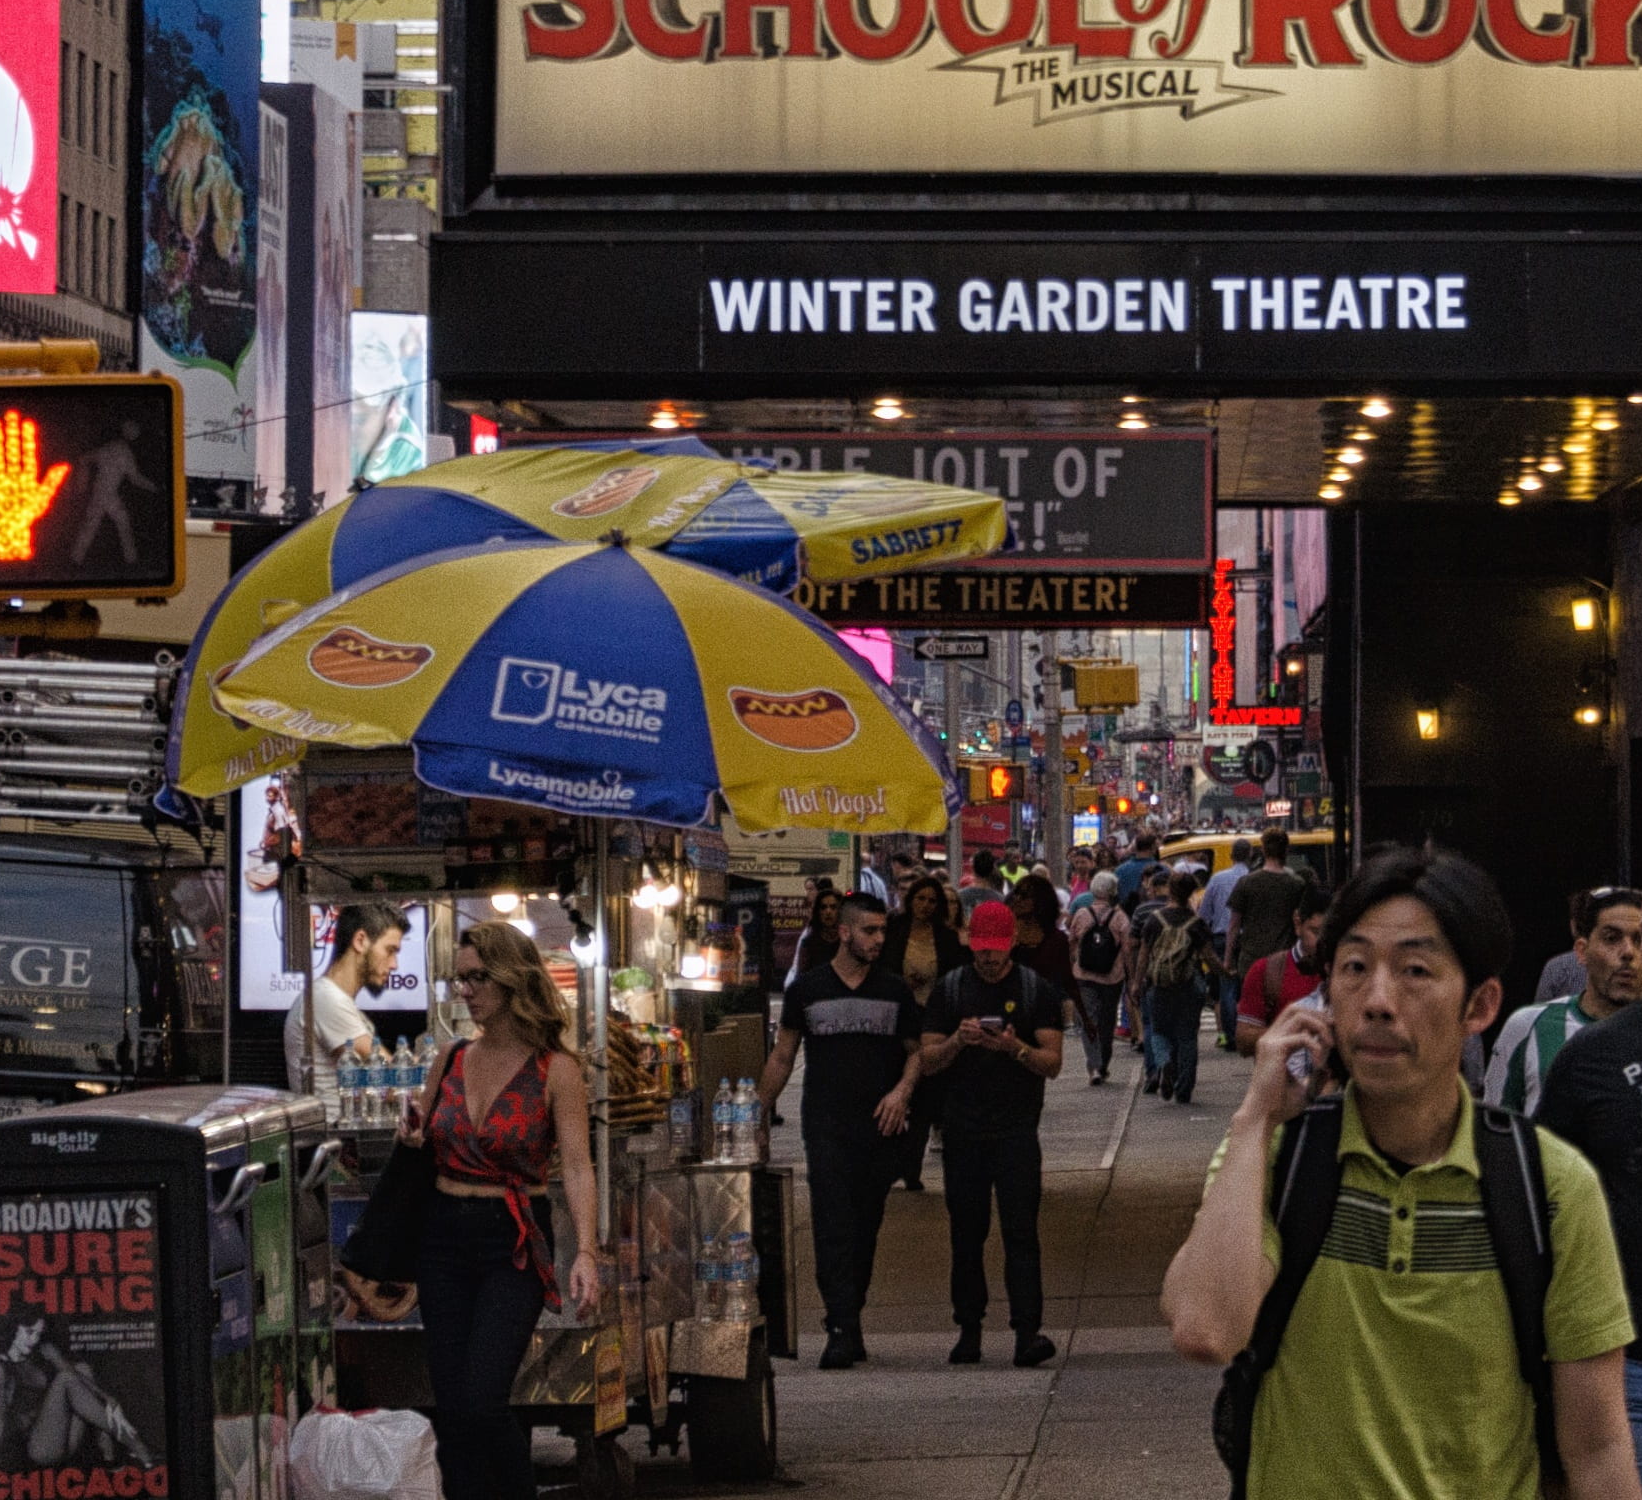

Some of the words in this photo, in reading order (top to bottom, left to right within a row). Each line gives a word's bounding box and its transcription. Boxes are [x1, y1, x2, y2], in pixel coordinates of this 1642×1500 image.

[1012, 56, 1061, 84] THE
[1049, 67, 1200, 111] MUSICAL
[710, 280, 936, 332] WINTER
[957, 280, 1186, 332] GARDEN
[1213, 277, 1467, 330] THEATRE
[1053, 447, 1123, 498] OF
[850, 519, 963, 564] SABRETT
[793, 577, 857, 611] OFF
[873, 577, 941, 611] THE
[926, 643, 949, 654] ONE
[956, 643, 979, 654] WAY
[1209, 559, 1236, 708] PLAYWRIGHT
[562, 671, 667, 711] Lyca
[557, 703, 662, 731] mobile
[1209, 707, 1301, 726] TAVERN
[489, 761, 636, 800] Lycamobile
[780, 787, 818, 815] Hot
[825, 787, 885, 822] Dogs!
[31, 1131, 98, 1148] BigBelly
[57, 1144, 90, 1153] SOLAR
